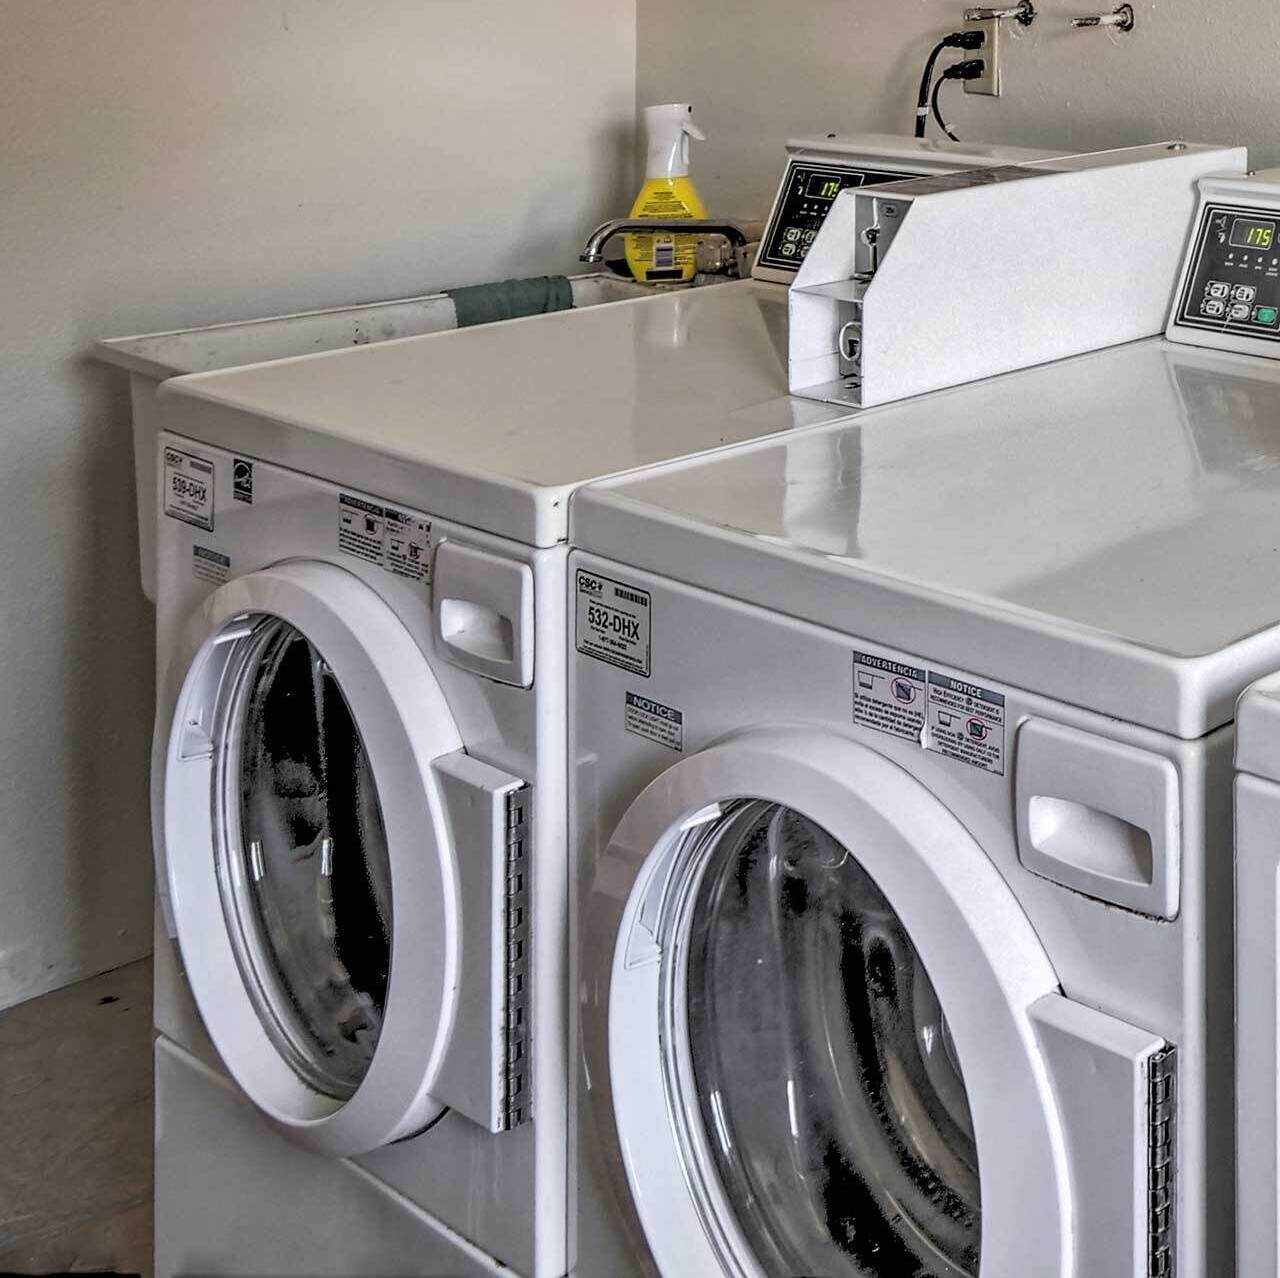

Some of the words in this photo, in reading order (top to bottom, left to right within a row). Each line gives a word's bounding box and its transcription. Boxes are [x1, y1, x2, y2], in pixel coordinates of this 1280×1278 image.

[1247, 228, 1272, 246] 175
[579, 576, 597, 590] CSC
[588, 606, 640, 640] 532-DHX
[860, 655, 919, 679] ADVERTENCIA
[950, 680, 982, 698] NOTICE
[633, 696, 675, 721] NOTICE
